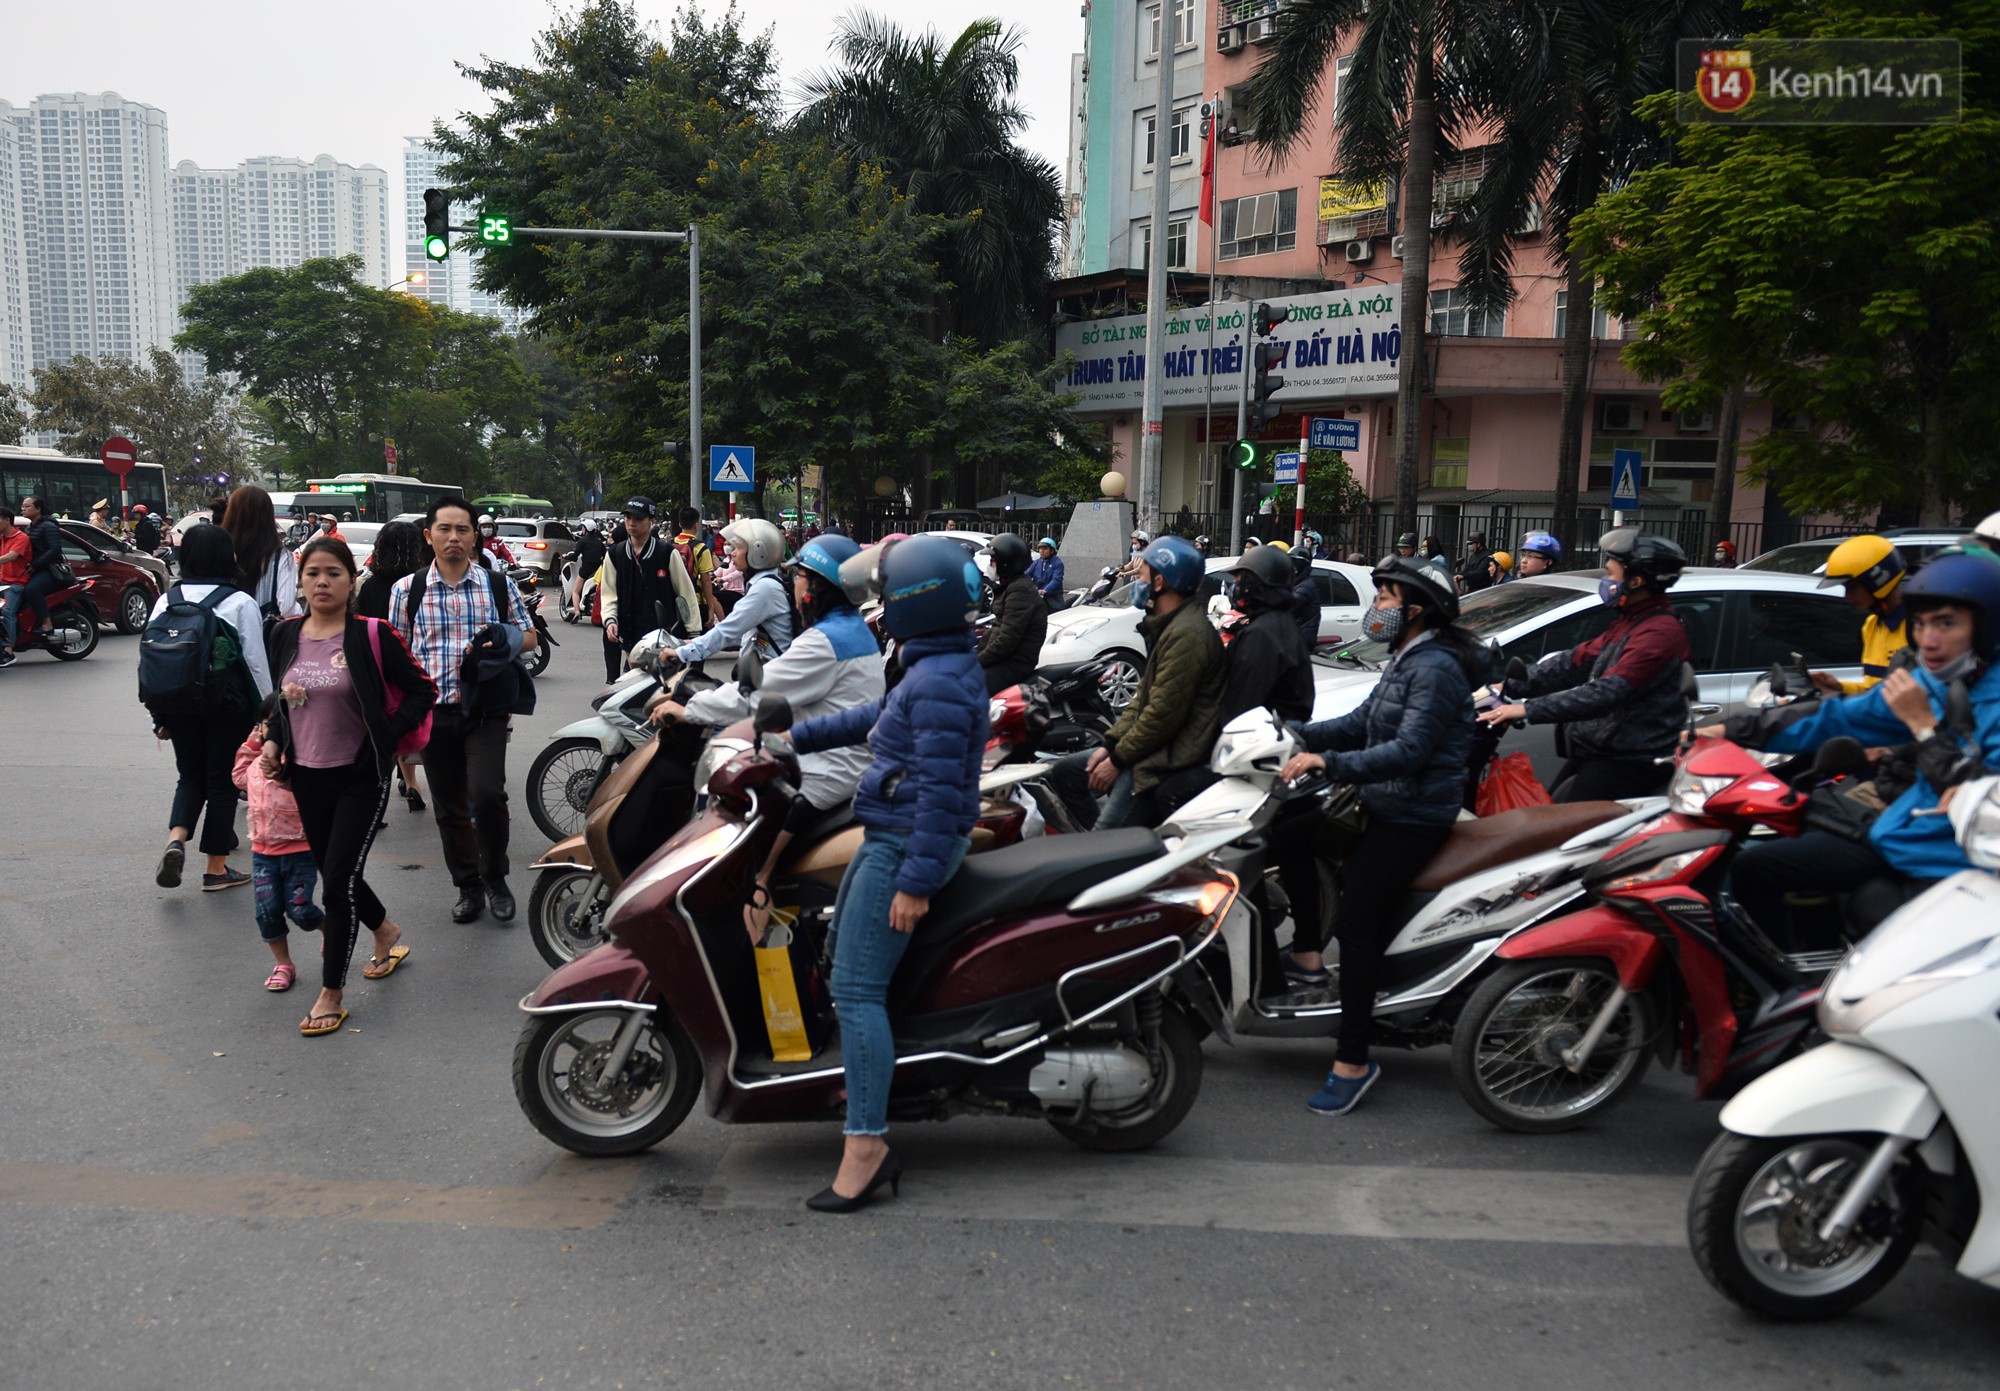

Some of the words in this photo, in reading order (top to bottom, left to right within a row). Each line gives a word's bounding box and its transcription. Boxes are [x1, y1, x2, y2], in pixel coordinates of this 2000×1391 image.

[483, 218, 509, 241] 25
[1082, 323, 1100, 345] SỞ
[1103, 325, 1125, 342] TÀI
[1327, 298, 1354, 319] HÀ
[1358, 293, 1393, 319] NỘI
[1295, 328, 1332, 368] ĐẤT
[1337, 327, 1365, 365] HÀ
[1204, 384, 1222, 393] TANH
[806, 548, 829, 566] UBER
[1666, 903, 1706, 911] HONDA
[1094, 911, 1161, 933] LEAD
